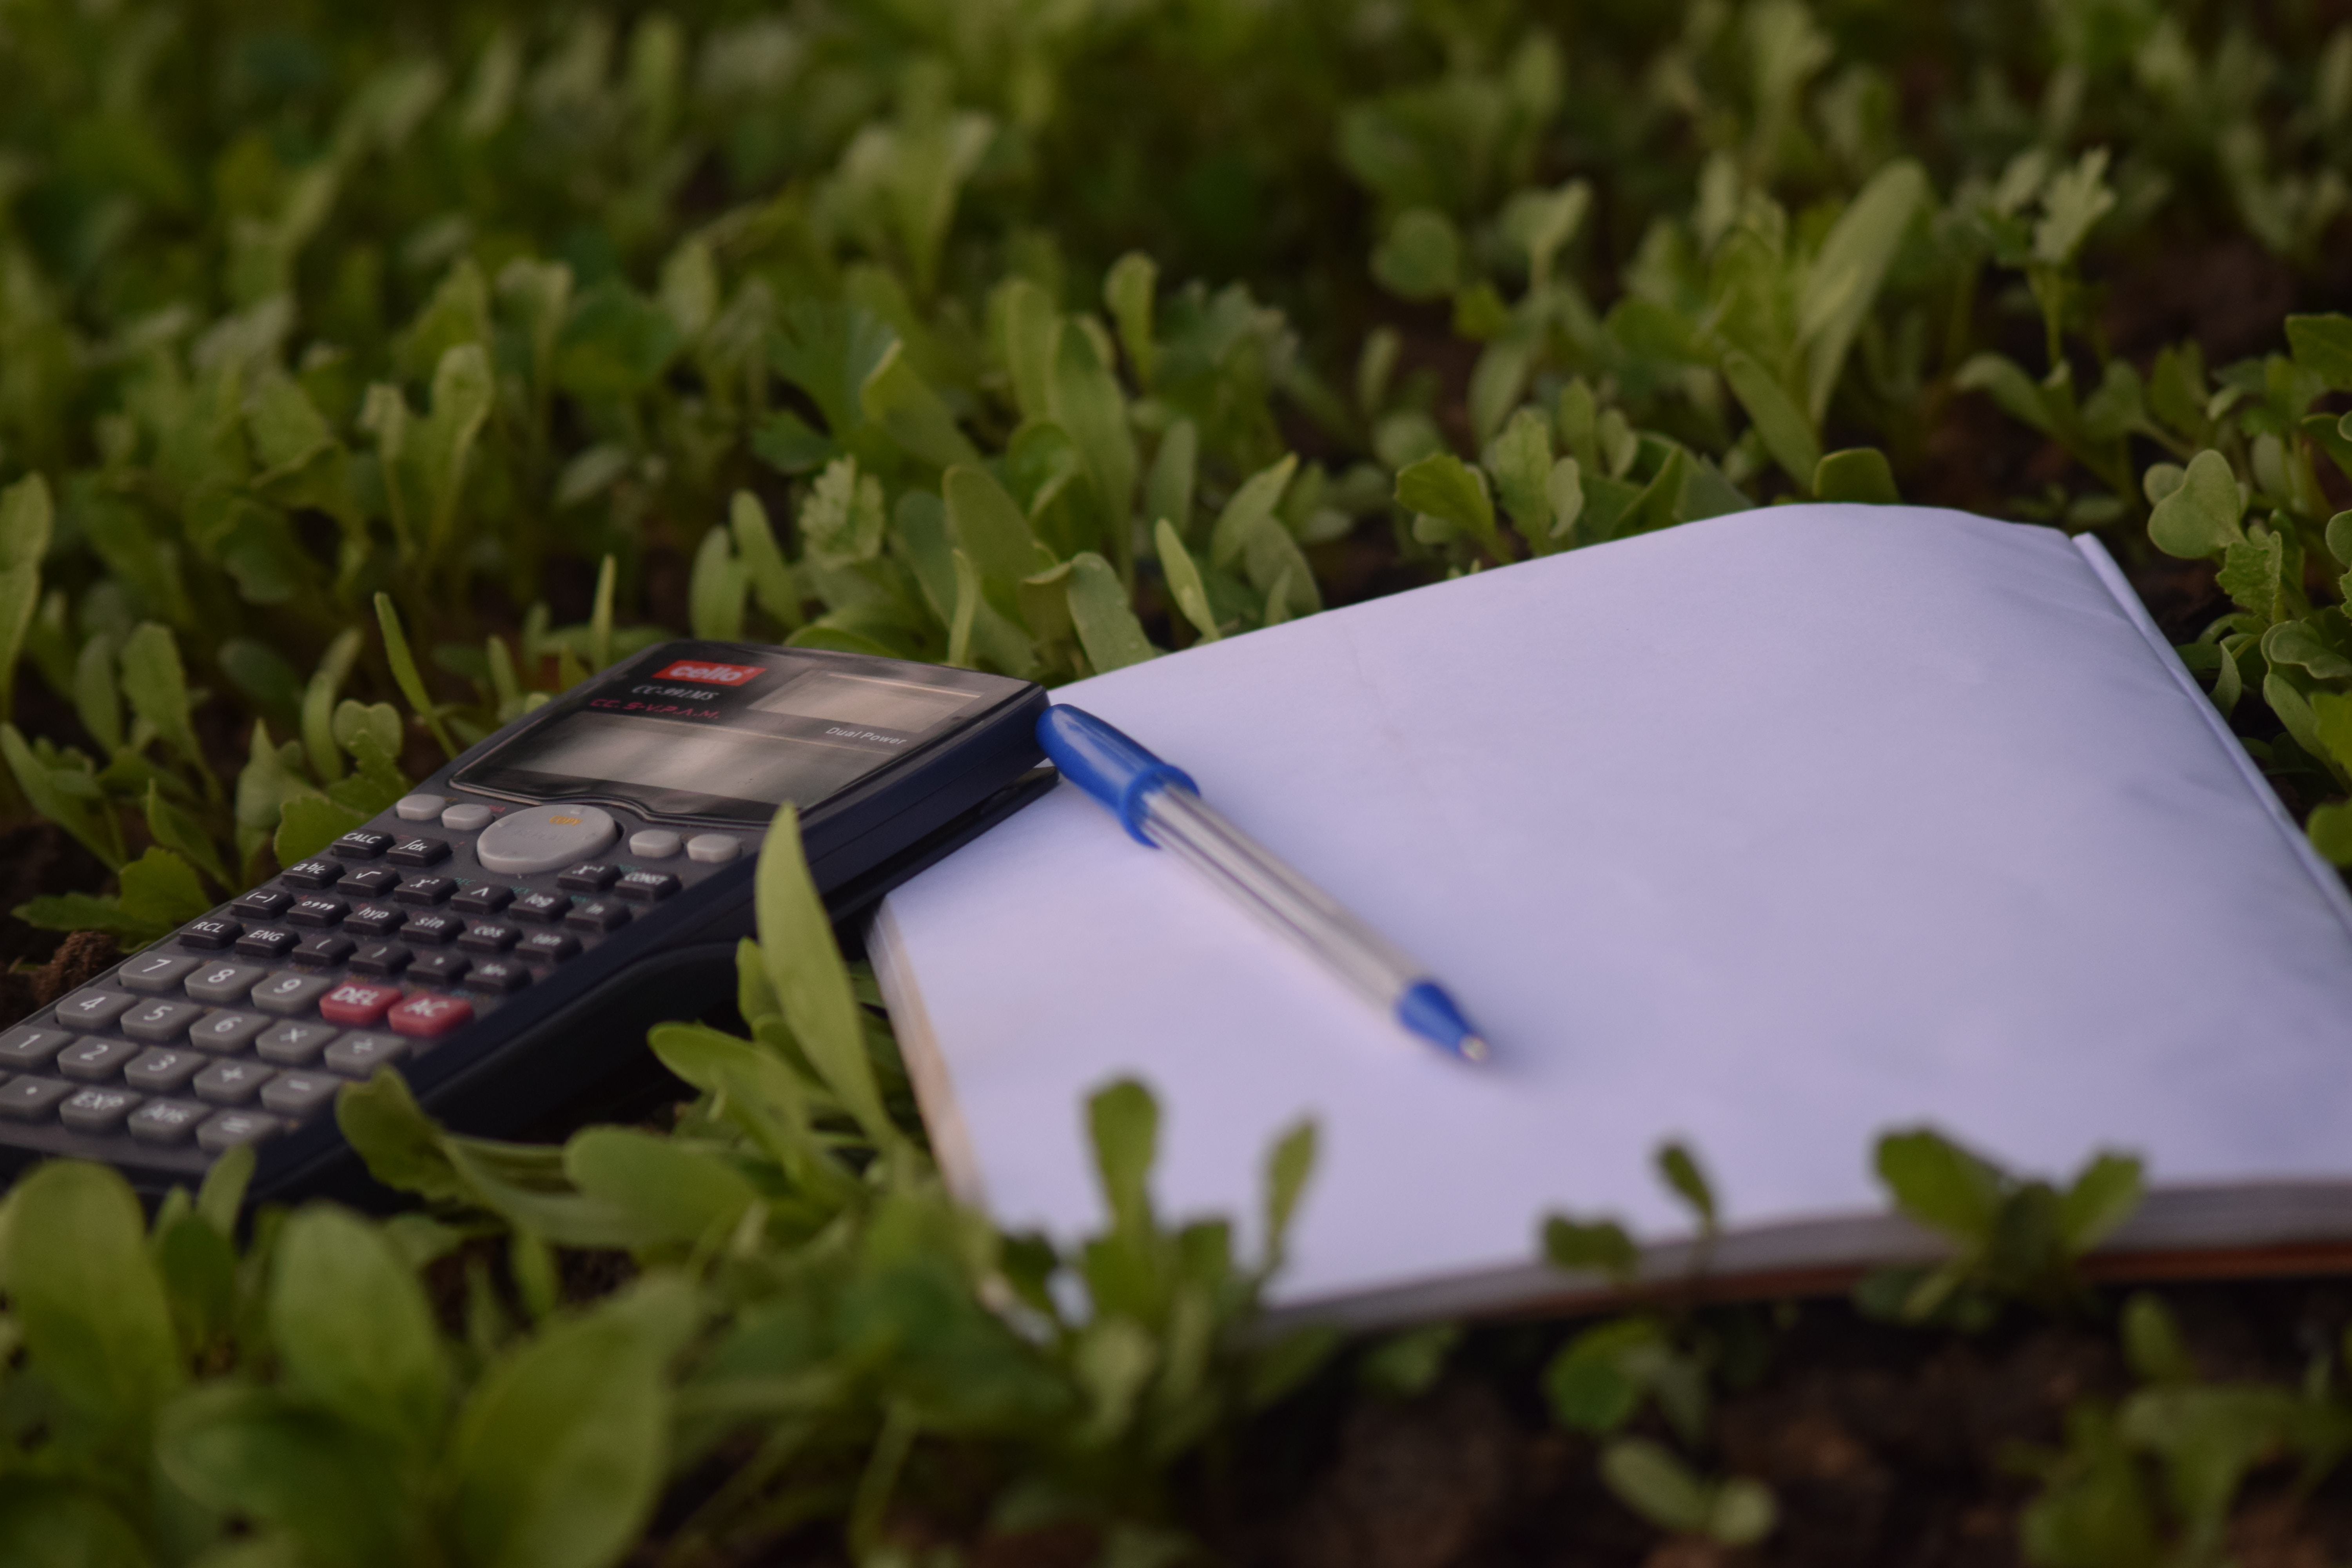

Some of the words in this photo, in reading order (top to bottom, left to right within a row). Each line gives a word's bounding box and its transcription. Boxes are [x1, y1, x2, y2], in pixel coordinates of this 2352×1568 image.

[669, 665, 742, 682] cello
[826, 727, 860, 738] Dual
[860, 732, 907, 744] Power
[343, 832, 382, 844] CALC
[525, 893, 555, 907] log
[358, 906, 390, 920] hyp
[192, 921, 225, 933] RCL
[415, 916, 446, 929] sin
[249, 930, 285, 942] ENG
[473, 925, 506, 938] cos
[142, 958, 172, 973] 7
[207, 968, 236, 983] 8
[274, 977, 302, 994] 9
[79, 996, 107, 1011] 4
[330, 986, 380, 1007] DEL
[143, 1005, 173, 1021] 5
[403, 998, 450, 1018] AC
[214, 1016, 243, 1033] 6
[19, 1033, 42, 1049] 1
[79, 1044, 109, 1061] 2
[147, 1054, 177, 1072] 3
